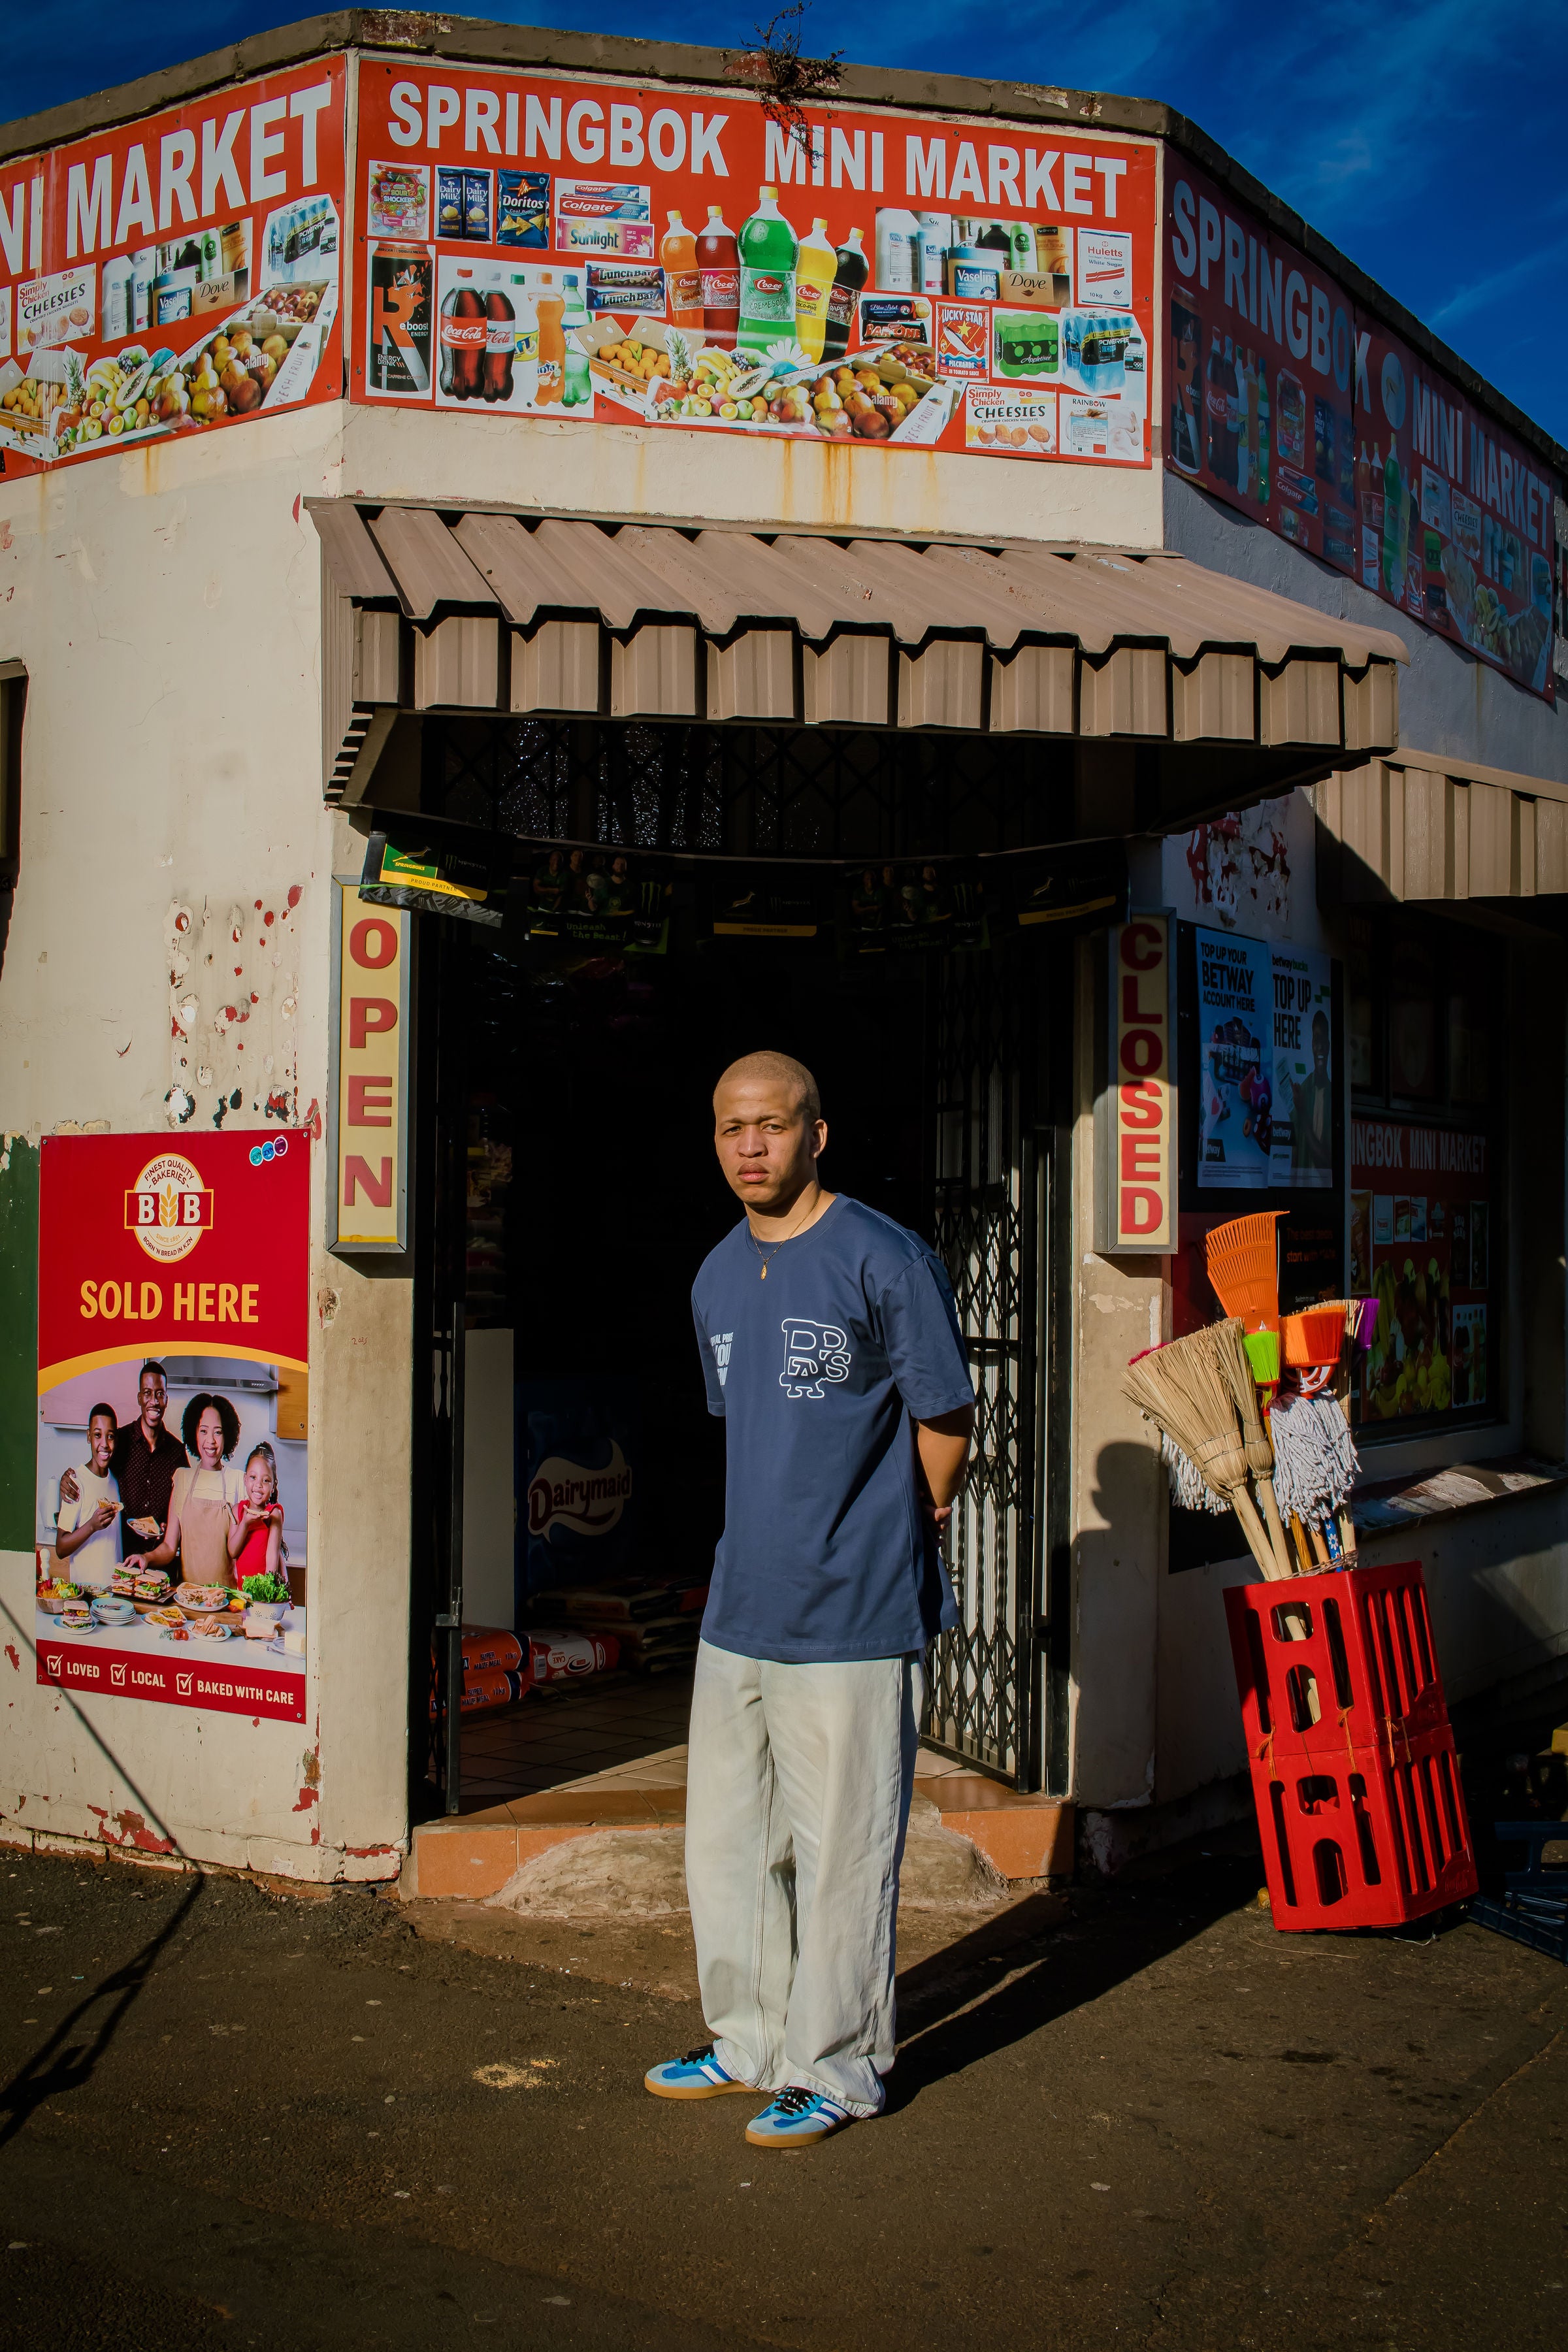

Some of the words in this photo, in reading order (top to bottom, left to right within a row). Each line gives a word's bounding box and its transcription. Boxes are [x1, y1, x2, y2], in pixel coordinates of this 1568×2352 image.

[387, 81, 730, 176] SPRINGBOK
[765, 120, 884, 192] MINI
[906, 135, 1127, 218] MARKET
[67, 82, 331, 259] MARKET
[440, 186, 461, 195] Dairy
[466, 187, 488, 197] Dairy
[502, 195, 546, 210] Doritos
[562, 200, 614, 212] Colgate
[570, 229, 619, 250] Sunlight
[1088, 246, 1123, 257] Huletts
[957, 269, 996, 283] Vaseline
[1009, 272, 1046, 289] Dove
[19, 281, 48, 300] Simply
[199, 281, 229, 298] Dove
[757, 279, 783, 290] Coo-ee
[22, 289, 50, 308] Chicken
[24, 283, 86, 319] CHEESIES
[159, 291, 190, 309] Vaseline
[942, 309, 964, 323] LUCKY
[966, 312, 983, 327] STAR
[442, 324, 483, 340] Coca-Cola
[244, 353, 269, 369] alamy
[378, 353, 401, 362] ENERGY
[949, 360, 974, 369] PILCHARDS
[1021, 355, 1052, 364] Appletiser
[1172, 179, 1371, 414] SPRINGBOK
[1413, 376, 1462, 483] MINI
[1470, 420, 1550, 550] MARKET
[871, 394, 898, 408] alamy
[969, 389, 1002, 400] Simply
[971, 398, 1005, 407] Chicken
[1072, 399, 1106, 408] RAINBOW
[973, 406, 1045, 419] CHEESIES
[1277, 481, 1303, 501] Colgate
[1454, 511, 1478, 529] CHEESIES
[395, 862, 426, 871] SPRINGBOKS
[410, 878, 431, 887] PROUD
[431, 882, 458, 892] PARTNER
[566, 923, 606, 931] Unleash
[572, 931, 590, 939] the
[1201, 942, 1215, 957] TOP
[1216, 947, 1227, 960] UP
[1228, 949, 1247, 965] YOUR
[1201, 960, 1254, 994] BETWAY
[1203, 990, 1236, 1009] ACCOUNT
[1237, 997, 1255, 1012] HERE
[1273, 973, 1295, 1010] TOP
[1298, 978, 1311, 1013] UP
[1274, 1013, 1301, 1049] HERE
[344, 919, 398, 1207] OPEN
[1120, 923, 1163, 1235] CLOSED
[1273, 1126, 1292, 1140] betway
[1410, 1129, 1436, 1171] MINI
[1440, 1132, 1486, 1173] MARKET
[144, 1160, 166, 1182] FINEST
[167, 1160, 195, 1181] QUALITY
[152, 1169, 187, 1186] BAKERIES
[138, 1194, 155, 1224] B
[183, 1194, 201, 1224] B
[143, 1236, 155, 1251] BORN
[183, 1236, 193, 1249] KZN
[155, 1233, 169, 1243] SINCE
[80, 1281, 163, 1320] SOLD
[174, 1282, 259, 1323] HERE
[529, 1469, 632, 1531] Dairymaid
[480, 1652, 495, 1660] SUPER
[474, 1660, 488, 1671] MAIZE
[488, 1658, 502, 1668] MEAL
[67, 1662, 100, 1678] LOVED
[131, 1670, 166, 1688] LOCAL
[197, 1679, 233, 1697] BAKED
[235, 1685, 263, 1701] WITH
[265, 1690, 294, 1705] CARE
[468, 1687, 483, 1695] SUPER
[462, 1697, 478, 1707] MAIZE
[478, 1695, 490, 1703] MEAL
